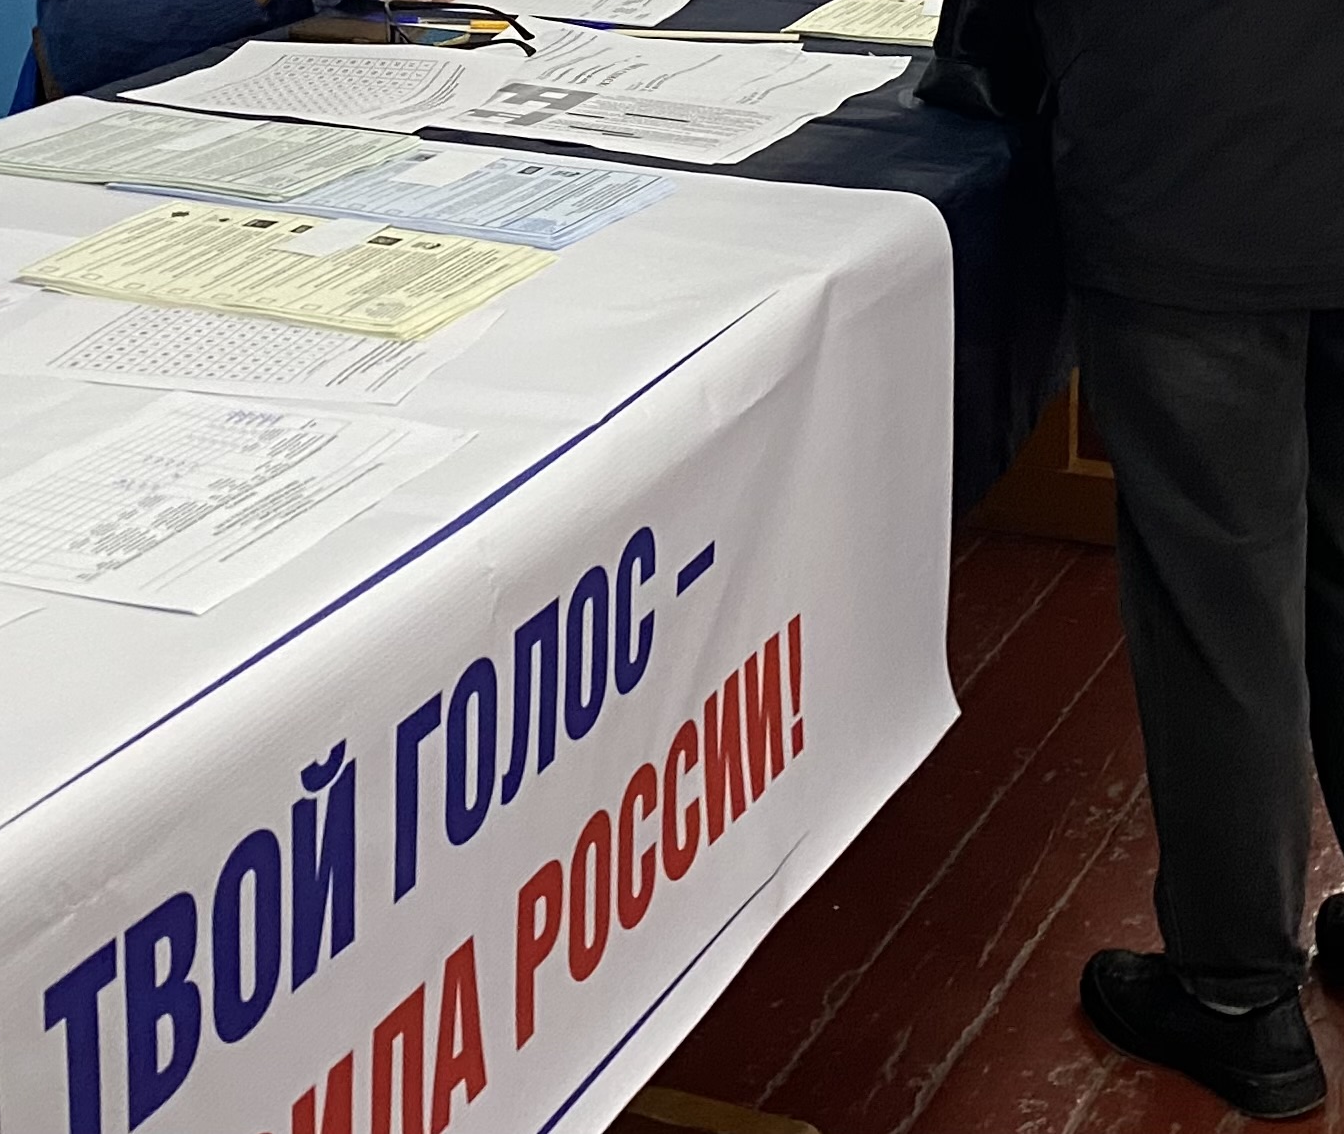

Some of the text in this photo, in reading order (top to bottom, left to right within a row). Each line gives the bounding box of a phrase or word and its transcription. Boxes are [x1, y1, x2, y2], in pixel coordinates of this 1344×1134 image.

[43, 740, 357, 1134] ТВОЙ
[393, 525, 656, 905] ГОЛОС
[514, 613, 805, 1052] РОССИИ!
